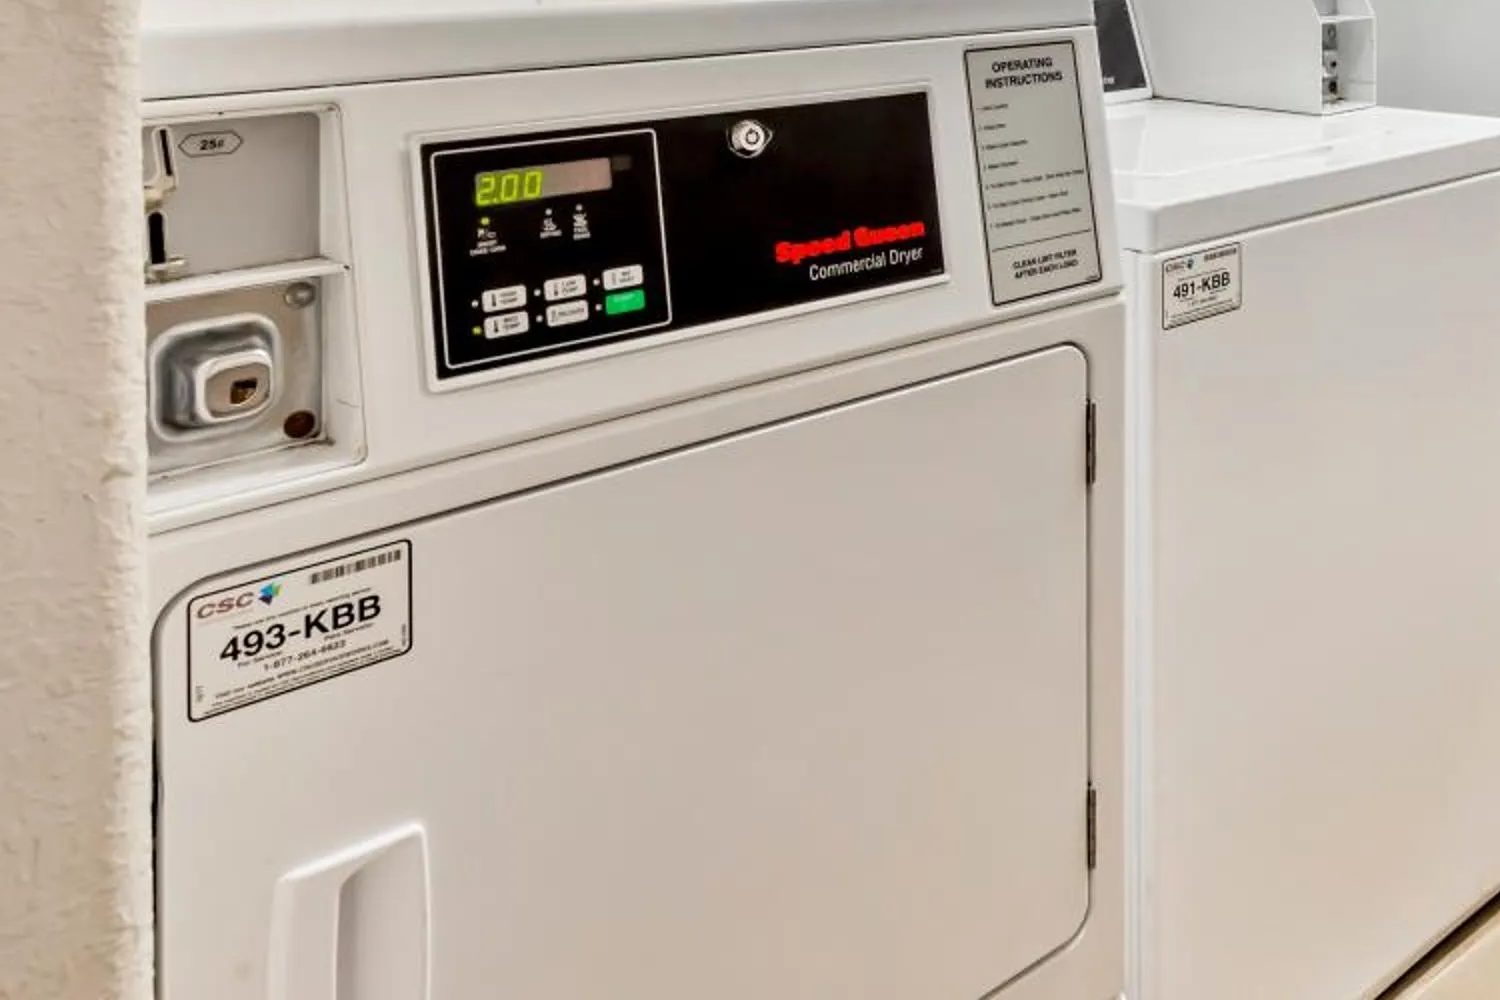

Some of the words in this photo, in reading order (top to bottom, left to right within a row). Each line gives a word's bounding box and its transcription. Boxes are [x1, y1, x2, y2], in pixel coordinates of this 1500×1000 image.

[991, 56, 1053, 73] OPERATING
[985, 71, 1063, 89] INSTRUCTIONS
[776, 230, 850, 264] Speed
[854, 221, 925, 247] Queen
[809, 251, 886, 281] Commercial
[889, 246, 924, 265] Dryer
[1173, 271, 1231, 298] 491-KBB
[197, 591, 255, 619] CSC
[219, 595, 382, 662] 493-KBB
